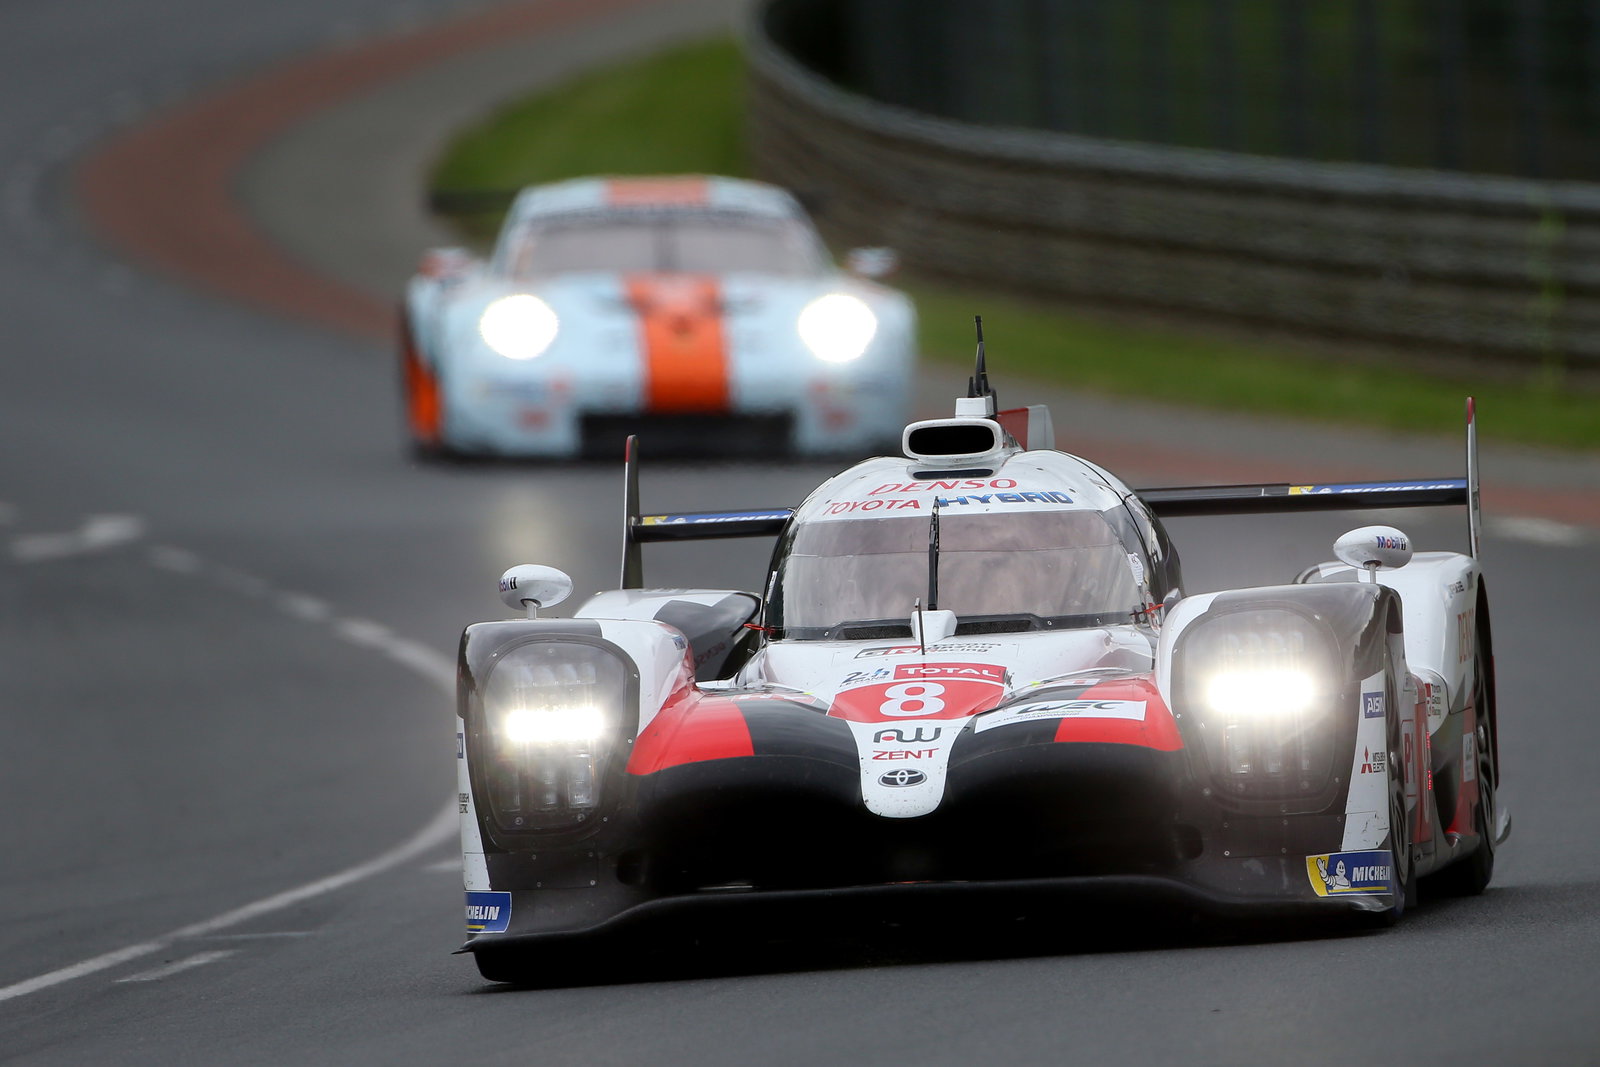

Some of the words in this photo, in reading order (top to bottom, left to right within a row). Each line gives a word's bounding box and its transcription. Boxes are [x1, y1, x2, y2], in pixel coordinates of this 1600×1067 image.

[868, 479, 1017, 496] DENSO
[822, 499, 921, 516] TOYOTA
[938, 491, 1074, 507] HYBRID
[694, 514, 790, 524] MICHELI
[901, 667, 1000, 678] TOTAL
[879, 682, 945, 716] 8
[1017, 701, 1125, 715] WEC
[872, 748, 940, 760] ZENT
